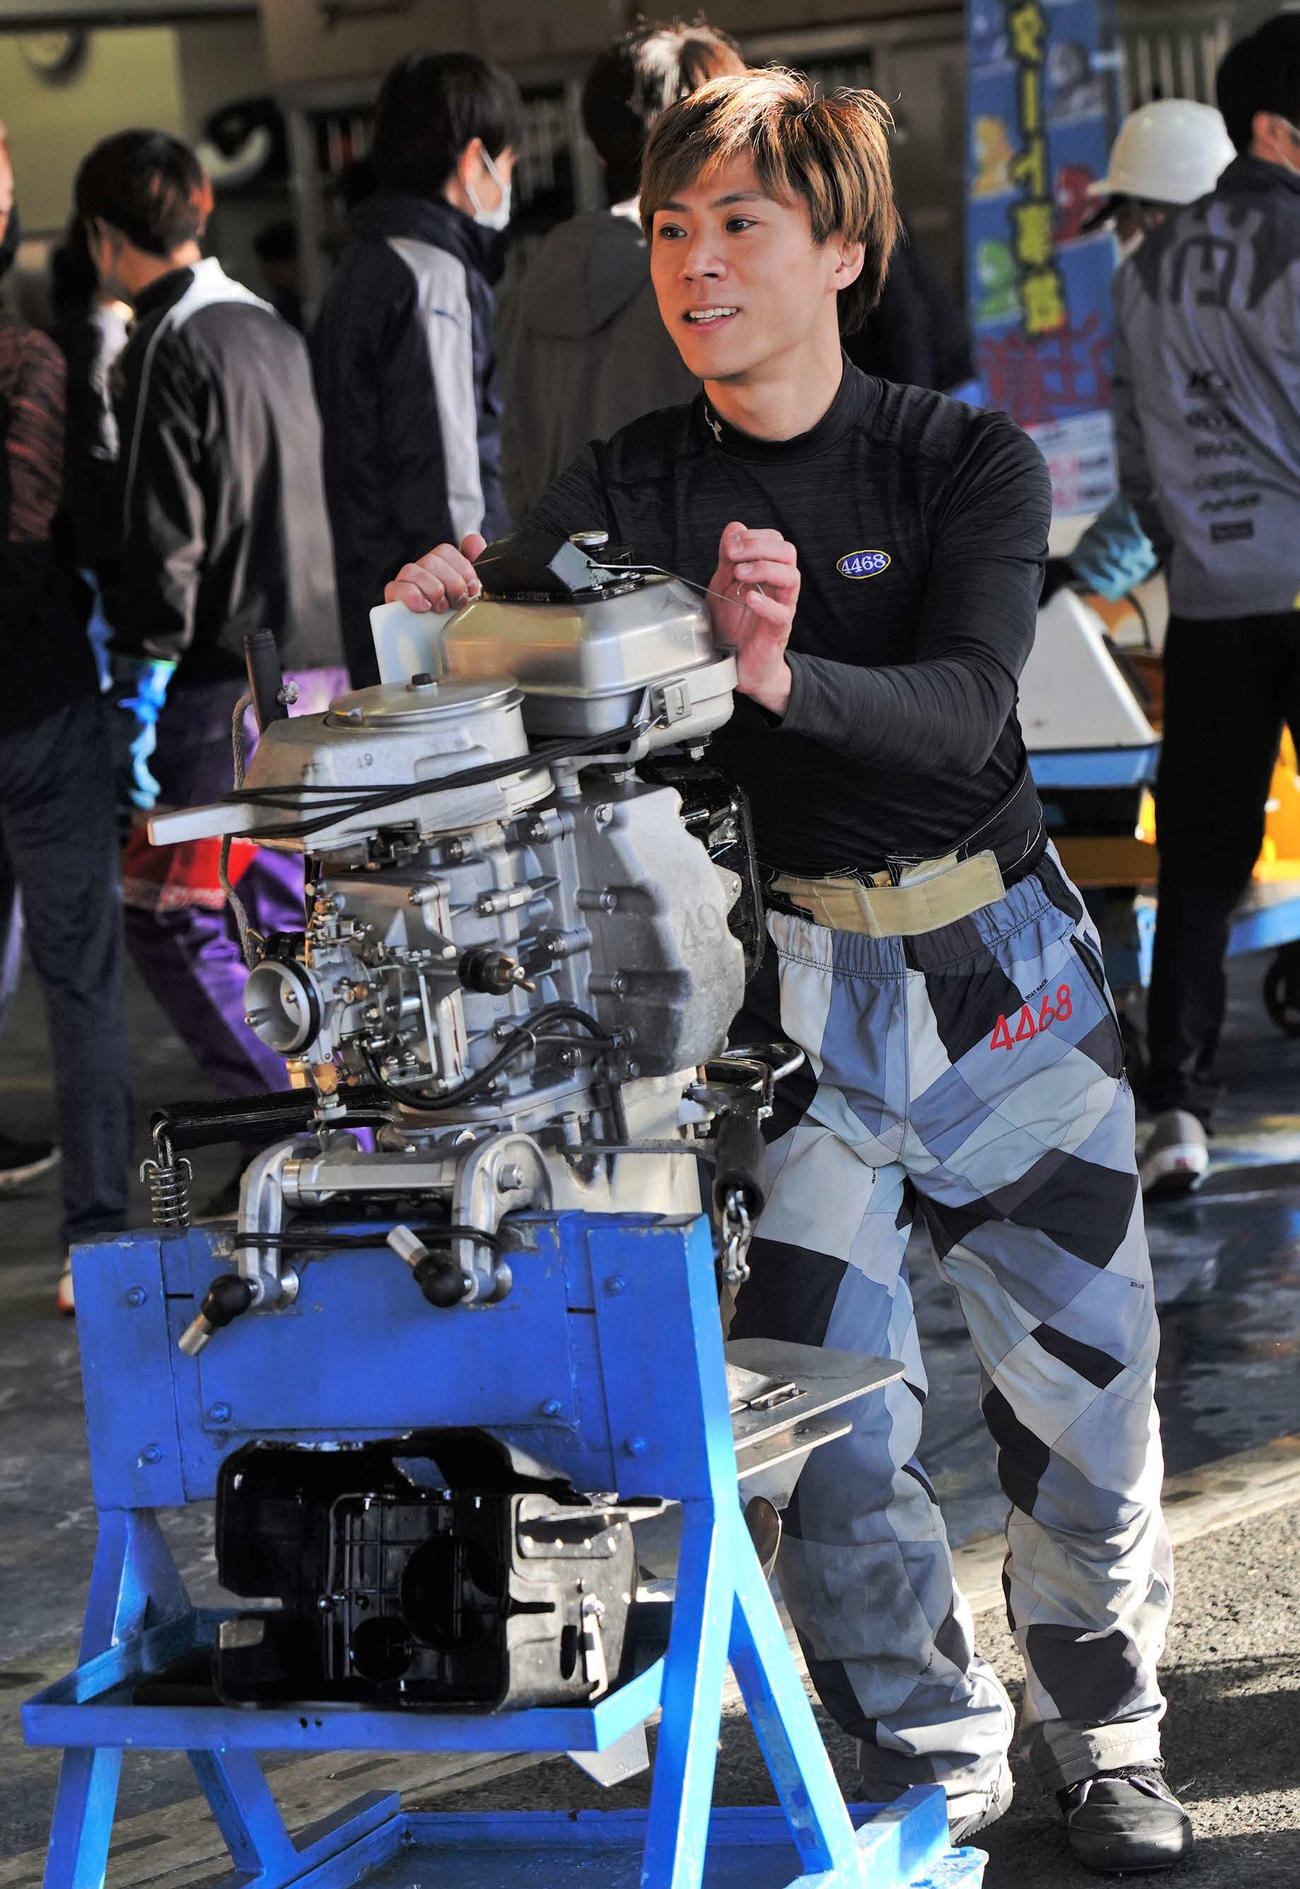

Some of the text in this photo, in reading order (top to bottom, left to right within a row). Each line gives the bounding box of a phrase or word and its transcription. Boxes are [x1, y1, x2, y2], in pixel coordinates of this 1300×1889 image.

[841, 554, 887, 574] 4468
[1025, 989, 1037, 1001] BOAT
[990, 984, 1073, 1051] 4468
